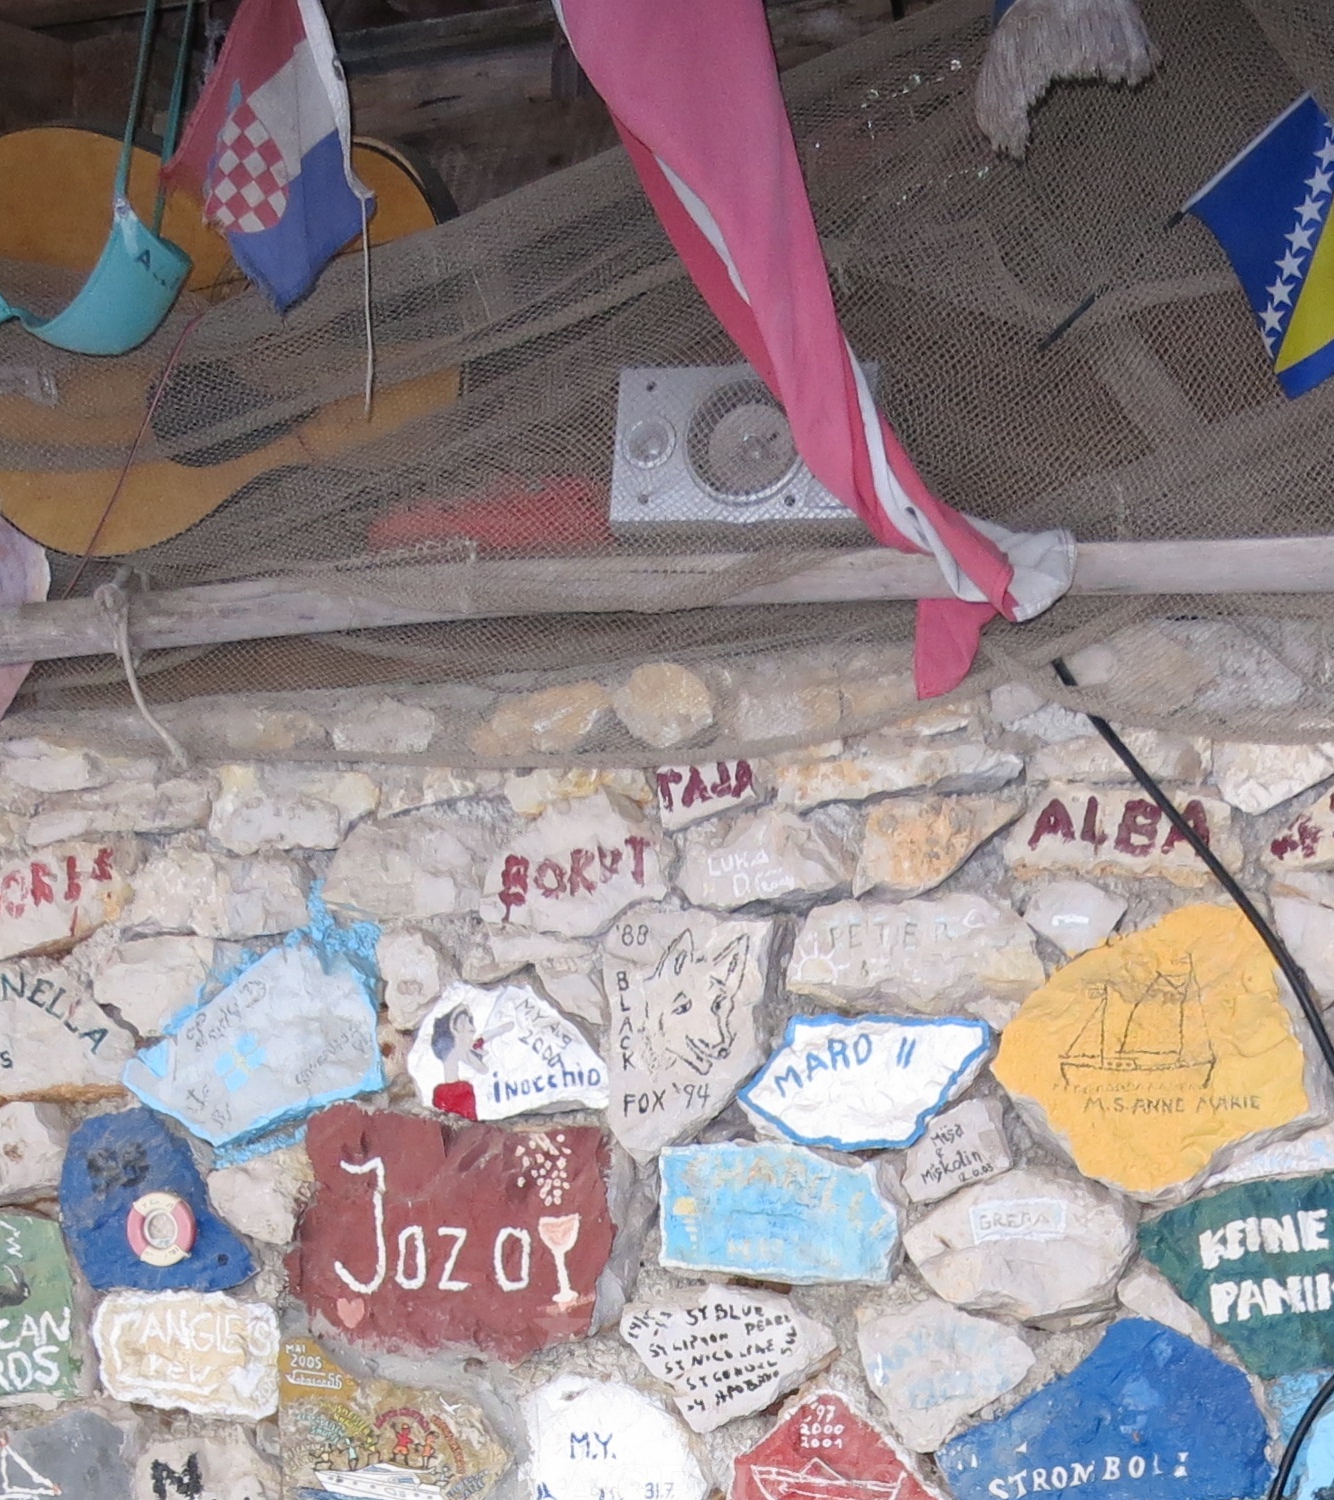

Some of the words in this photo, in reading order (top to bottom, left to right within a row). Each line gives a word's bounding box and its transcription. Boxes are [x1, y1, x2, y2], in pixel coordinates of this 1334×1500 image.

[615, 970, 638, 1071] BLACK
[623, 1092, 666, 1117] FOX
[1198, 1208, 1330, 1271] KEINE
[799, 1422, 846, 1438] 2000
